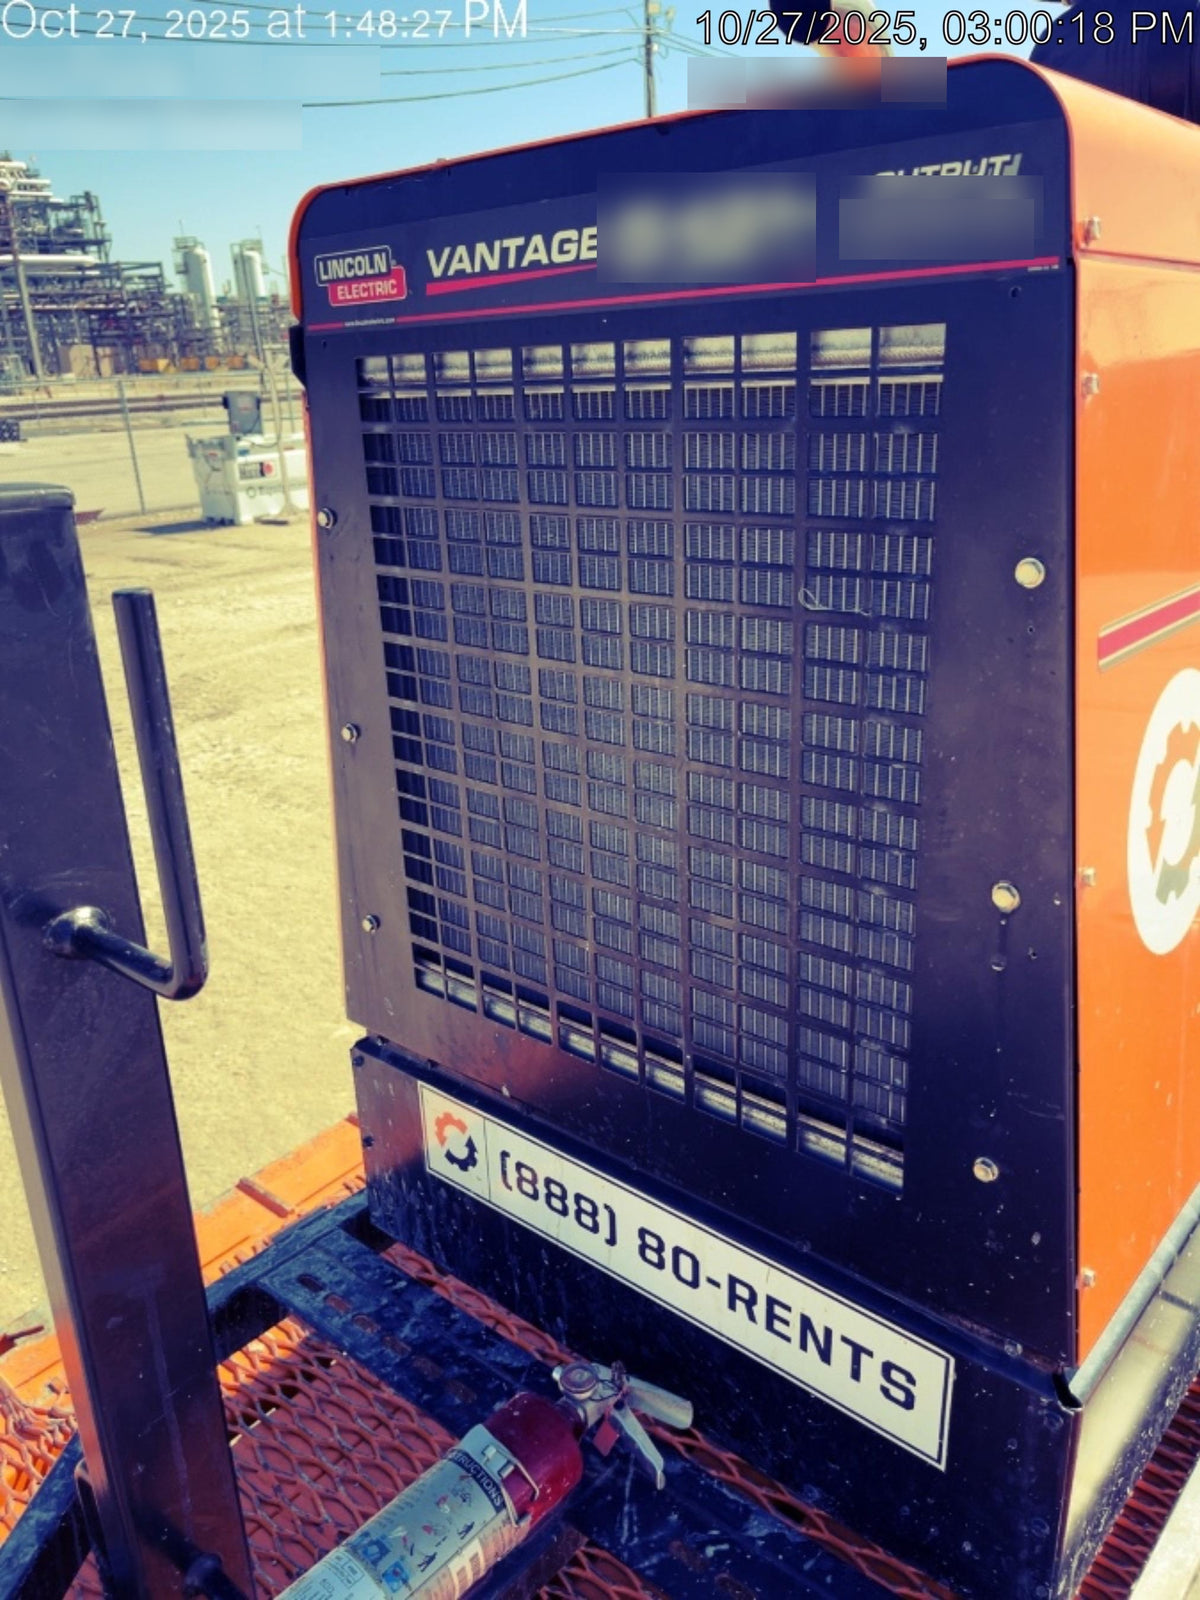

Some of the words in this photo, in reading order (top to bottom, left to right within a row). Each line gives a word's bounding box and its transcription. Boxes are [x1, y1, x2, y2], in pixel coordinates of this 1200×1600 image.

[319, 252, 388, 281] LINCOLN
[426, 226, 597, 278] VANTAGE
[337, 279, 397, 300] ELECTRIC
[500, 1150, 617, 1247] (888)
[637, 1226, 917, 1411] 80-RENTS
